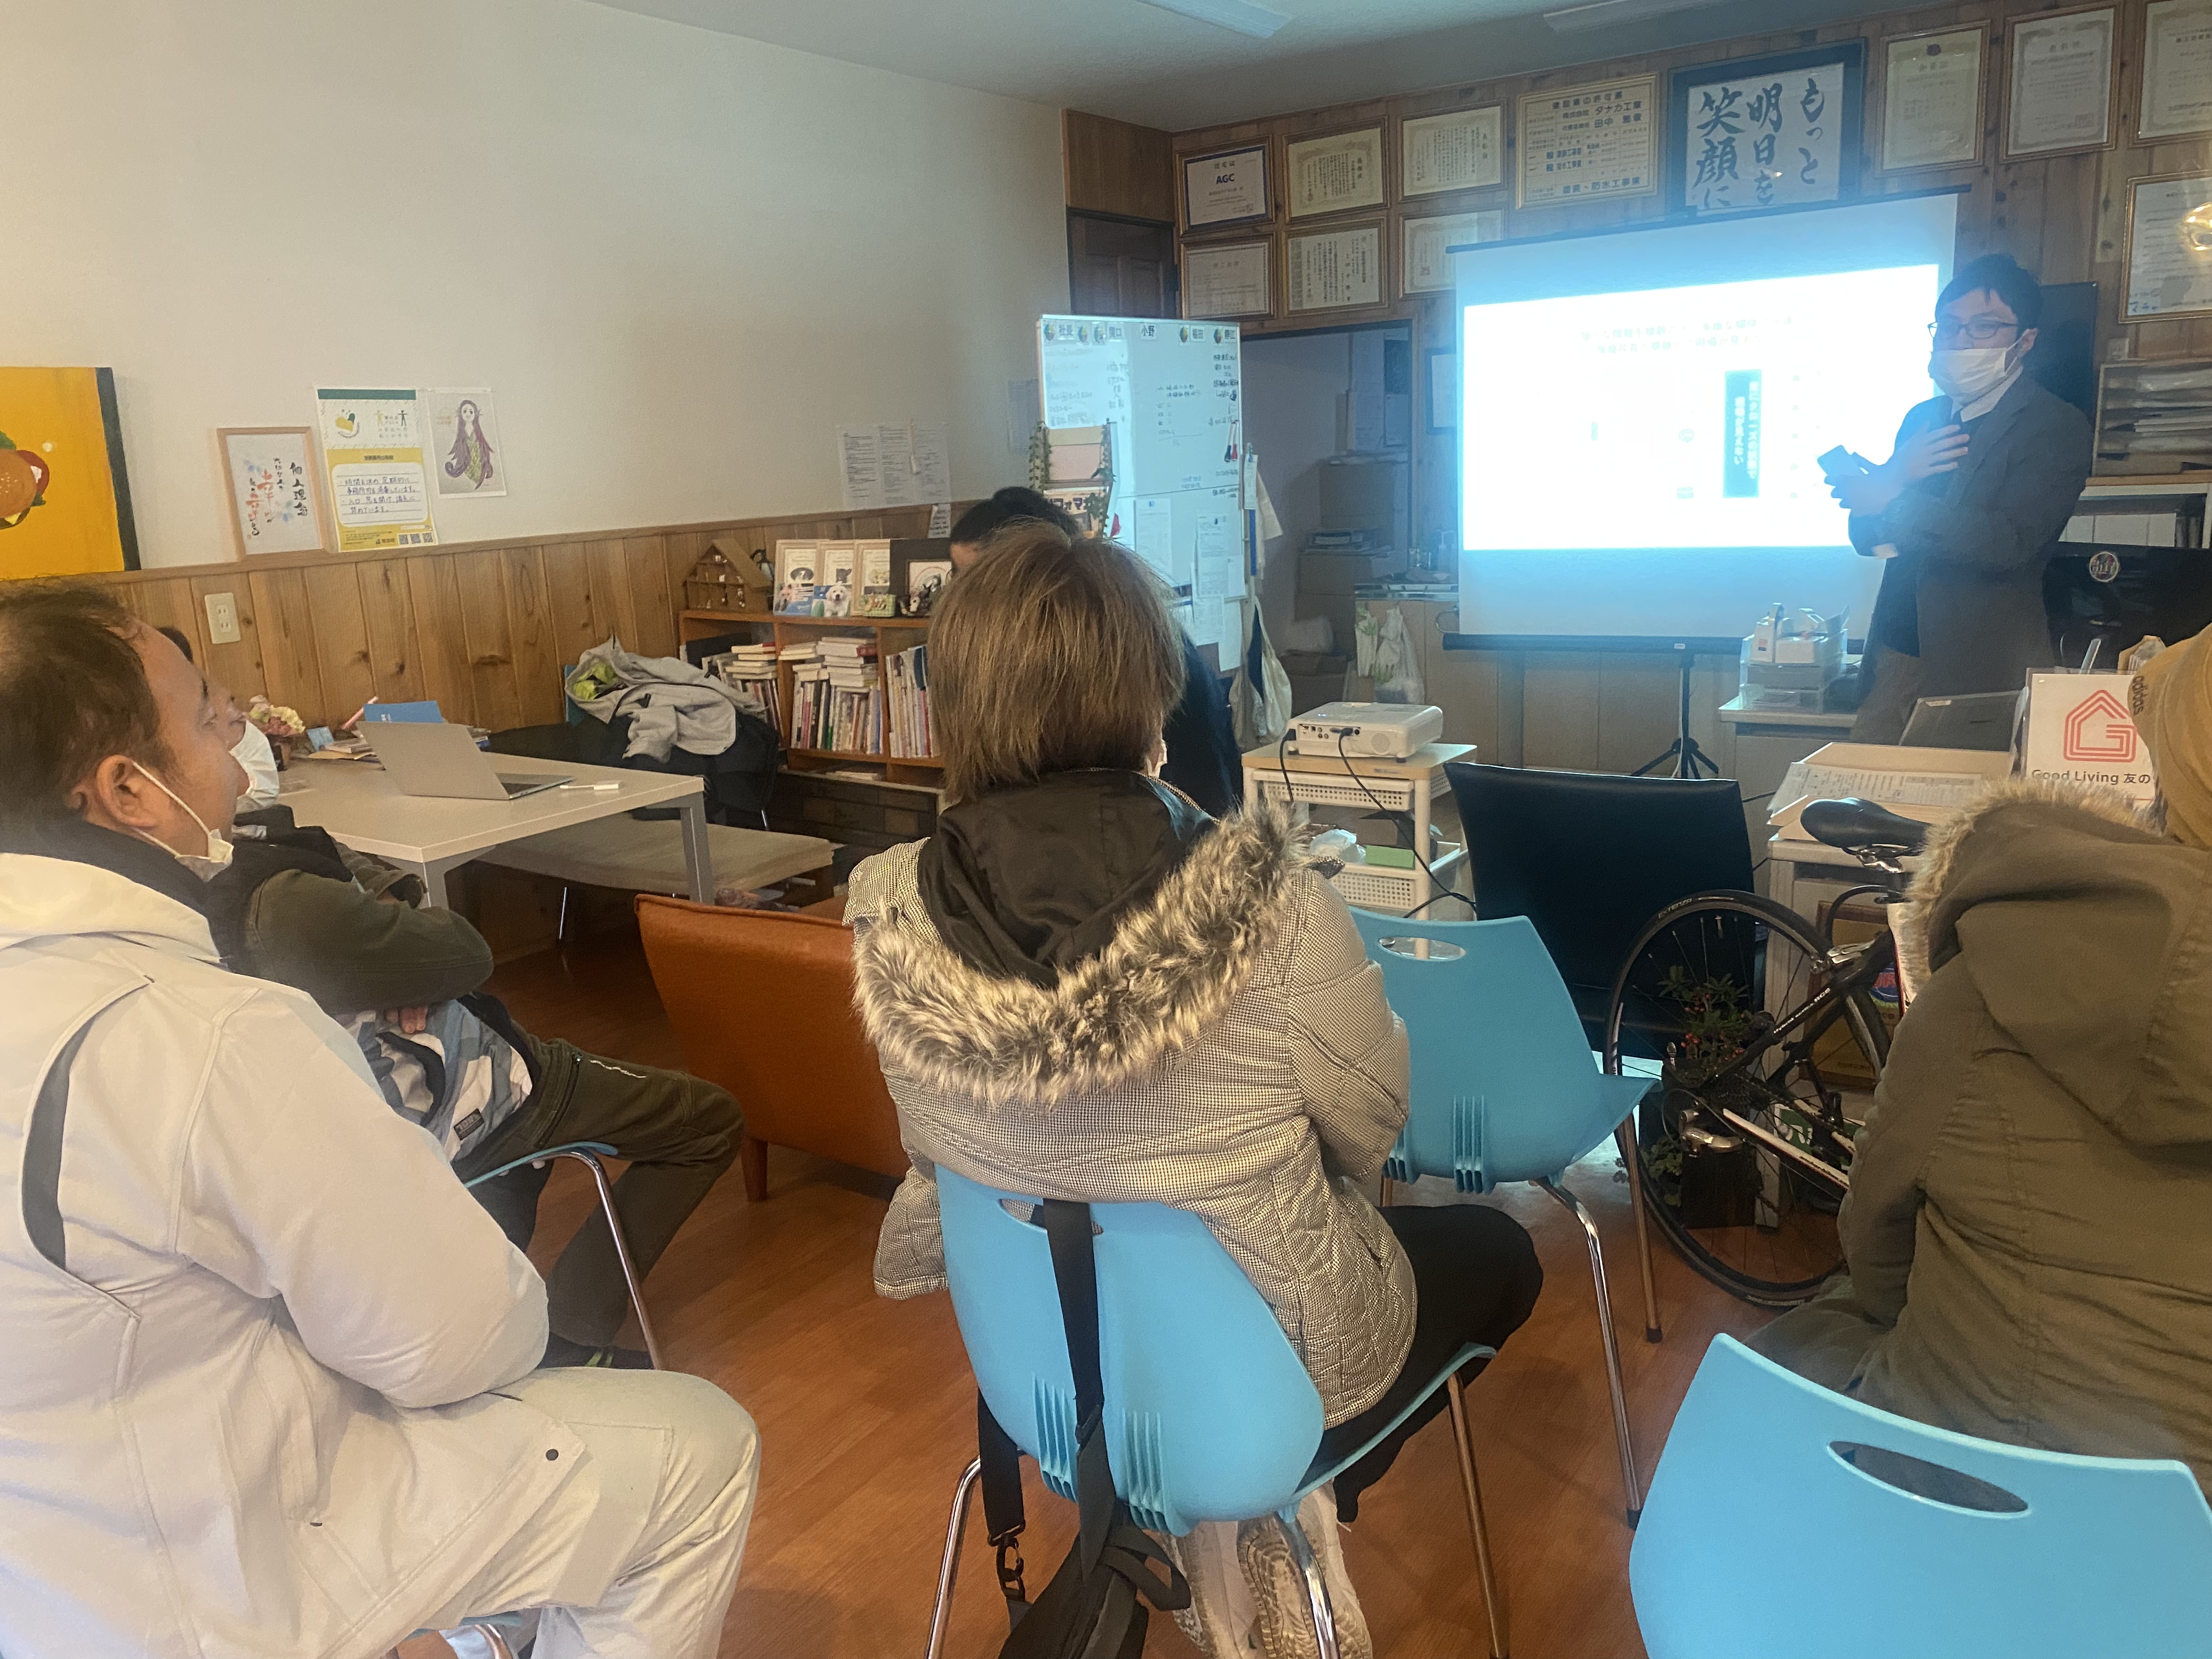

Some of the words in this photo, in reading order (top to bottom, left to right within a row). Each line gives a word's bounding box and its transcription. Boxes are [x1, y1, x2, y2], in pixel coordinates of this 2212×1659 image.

[1216, 173, 1235, 184] AGC
[1691, 87, 1747, 210] 笑顔に
[1746, 83, 1783, 205] 明日を
[1800, 78, 1825, 184] もっと
[2075, 771, 2119, 785] Living
[2123, 772, 2151, 783] 友の
